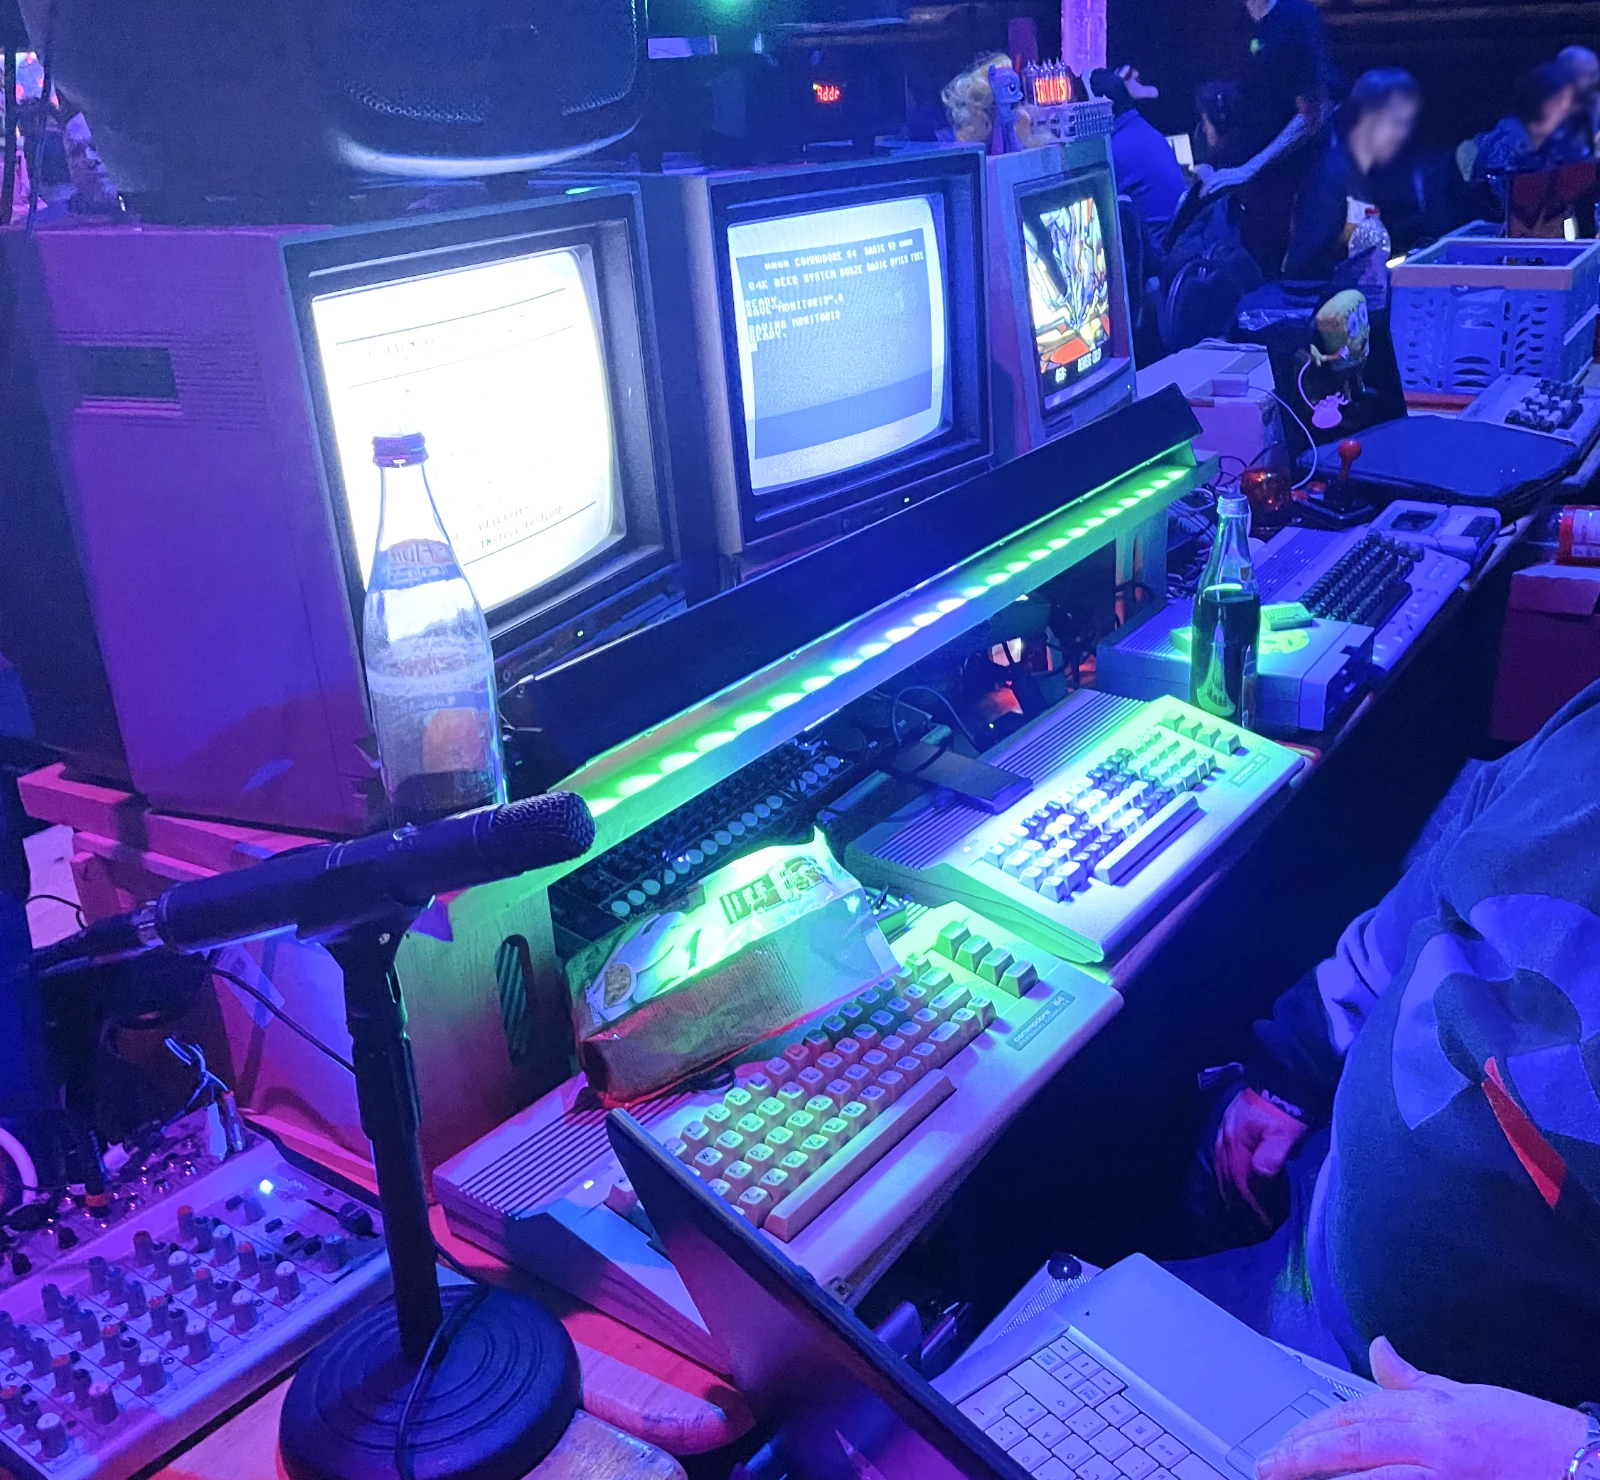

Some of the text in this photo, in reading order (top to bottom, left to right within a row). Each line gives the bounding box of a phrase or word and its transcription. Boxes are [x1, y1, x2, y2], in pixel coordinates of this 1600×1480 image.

[794, 250, 843, 267] COMMODORE
[846, 248, 857, 259] 64
[864, 243, 886, 256] BASIC
[748, 279, 769, 291] 64K
[866, 259, 888, 272] BASIC
